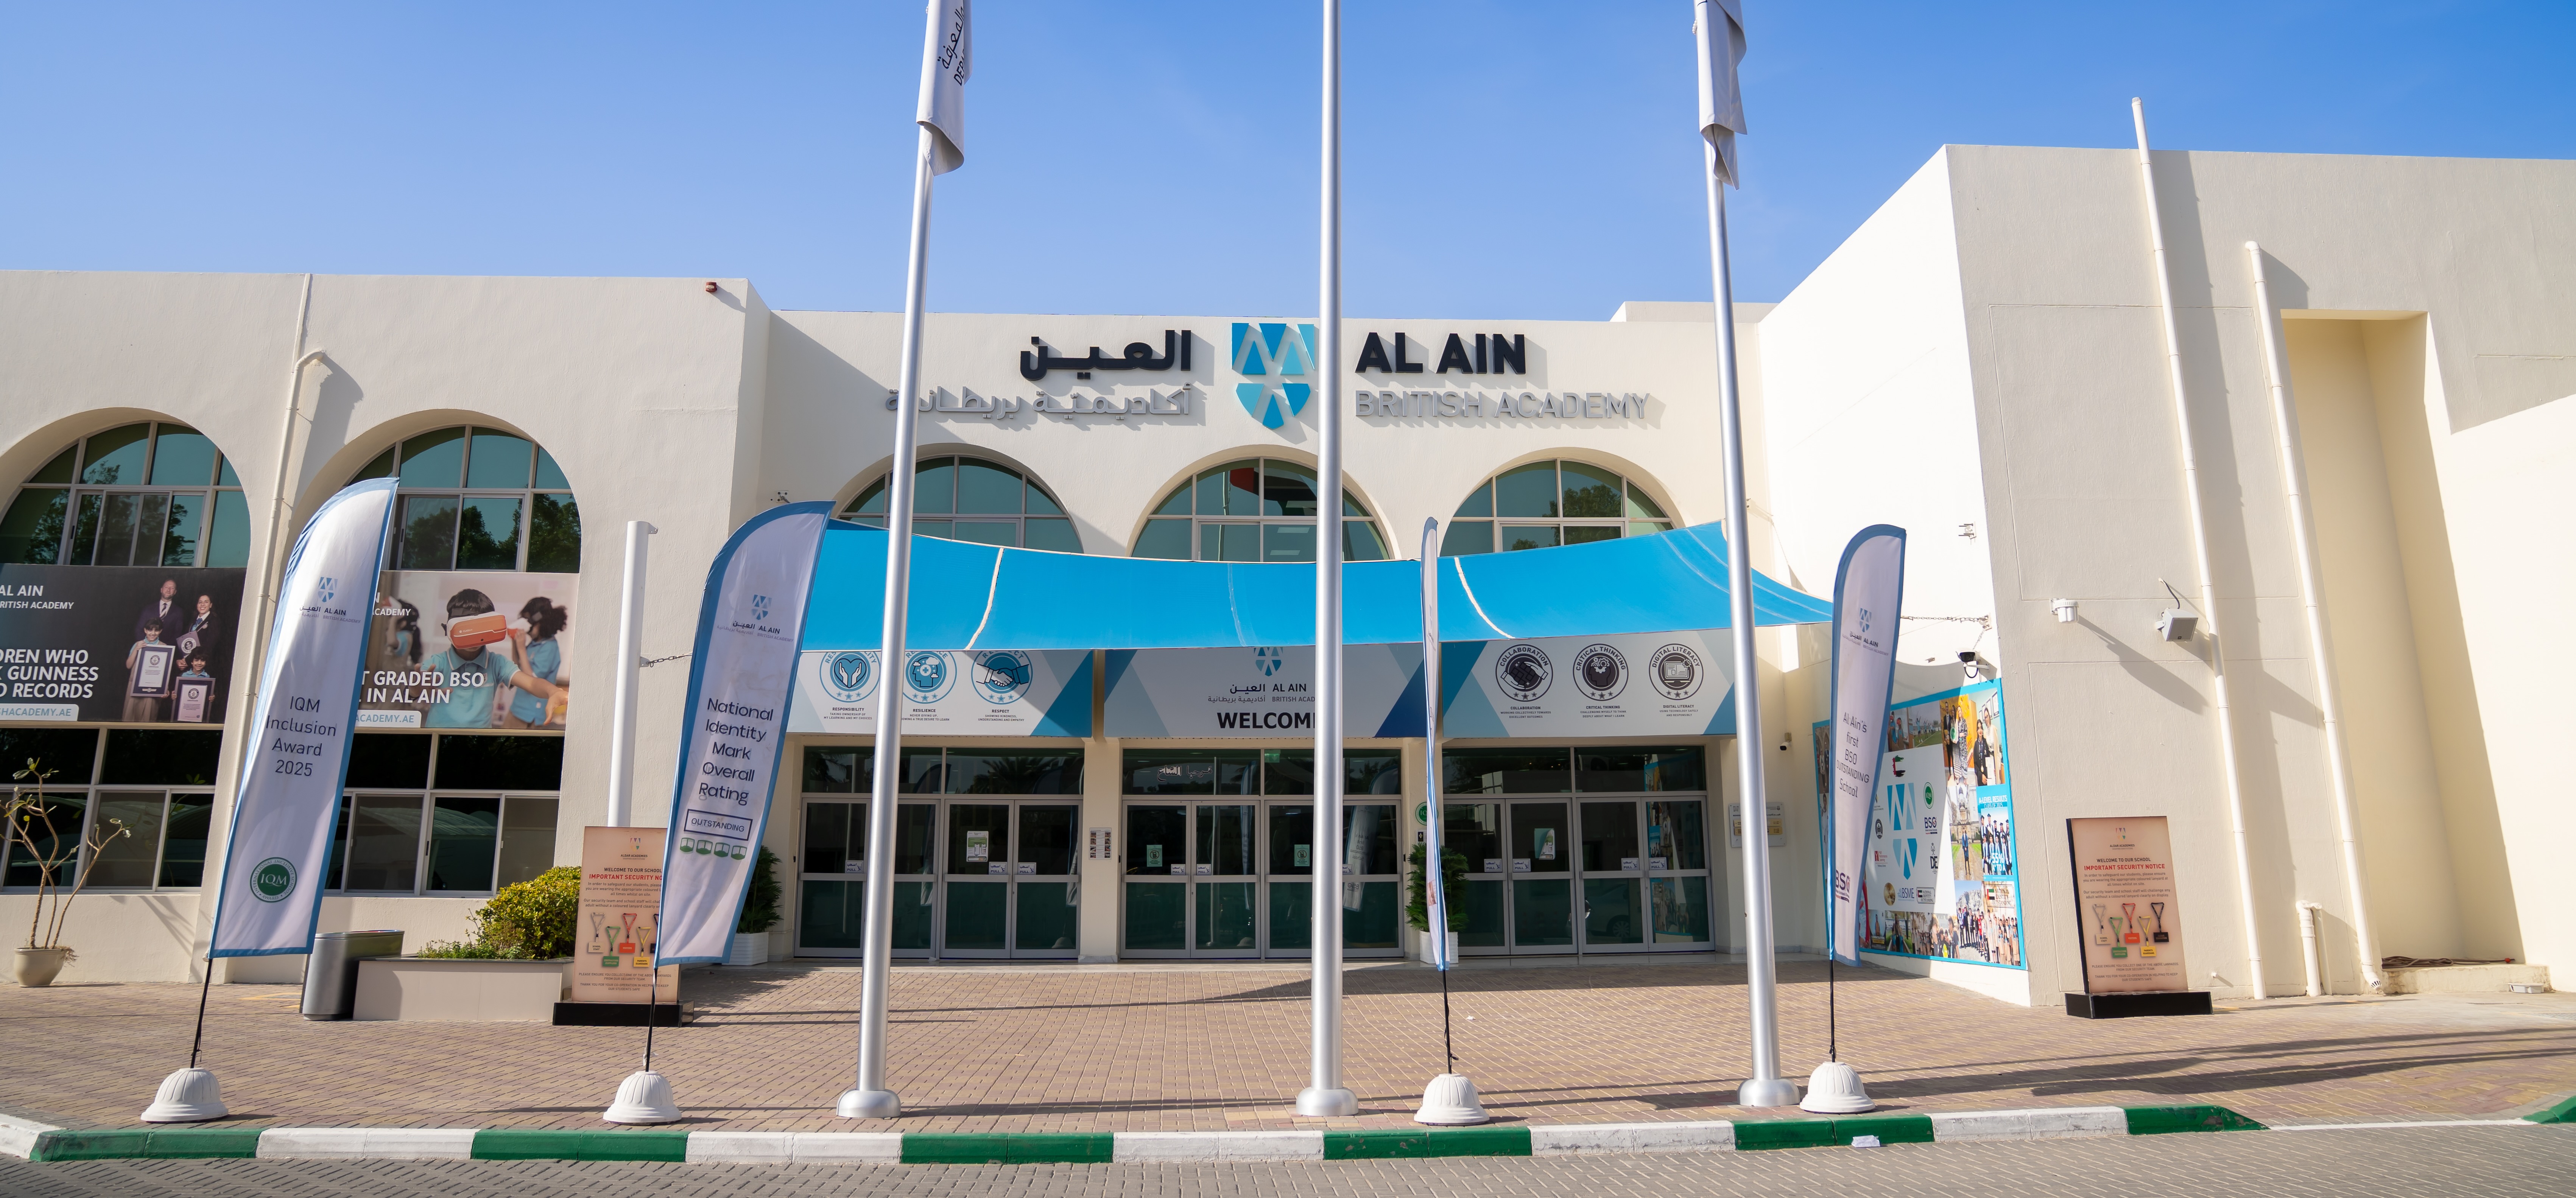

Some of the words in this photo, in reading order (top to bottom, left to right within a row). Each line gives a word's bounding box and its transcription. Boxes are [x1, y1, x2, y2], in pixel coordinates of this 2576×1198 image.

[1020, 330, 1191, 381] العين
[1355, 332, 1423, 373] AL
[1436, 333, 1526, 375] AIN
[886, 386, 1020, 420] بريطانة
[1355, 391, 1483, 418] BRITISH
[1494, 392, 1650, 419] ACADEMY
[0, 585, 14, 596] AL
[17, 585, 44, 596] AIN
[733, 621, 755, 629] العين
[45, 649, 89, 664] WHO
[1500, 647, 1549, 667] COLLABORATION
[1576, 647, 1598, 671] CRITICAL
[1599, 646, 1626, 670] THINKING
[1652, 647, 1671, 668] DIGITAL
[1673, 646, 1700, 667] LITERACY
[7, 666, 99, 681] GUINNESS
[374, 671, 444, 687] GRADED
[450, 671, 484, 688] BSO
[12, 683, 93, 699] RECORDS
[367, 688, 386, 703] IN
[391, 688, 413, 703] AL
[417, 689, 450, 704] AIN
[1230, 684, 1265, 694] العين
[290, 696, 320, 713] IQM
[707, 697, 773, 721] National
[266, 715, 336, 736] Inclusion
[356, 714, 414, 723] ACADEMY.AE
[1217, 712, 1315, 729] WELCOM
[1843, 712, 1849, 725] Al
[1850, 715, 1867, 733] Ain's
[706, 719, 767, 742] Identity
[272, 738, 322, 756] Award
[1847, 731, 1859, 748] first
[712, 741, 751, 760] Mark
[1845, 749, 1857, 765] BSO
[275, 759, 313, 776] 2025
[702, 762, 755, 782] Overall
[1836, 759, 1870, 783] OUTSTANDING
[699, 782, 749, 806] Rating
[1839, 778, 1858, 798] School
[691, 817, 745, 832] OUTSTANDING
[1992, 853, 2004, 864] 55%
[253, 860, 273, 893] INTERNATIONAL
[274, 859, 294, 875] INCLUSIVE
[284, 876, 294, 895] SCHOOL
[260, 874, 287, 887] IQM
[1902, 888, 1914, 898] BSME
